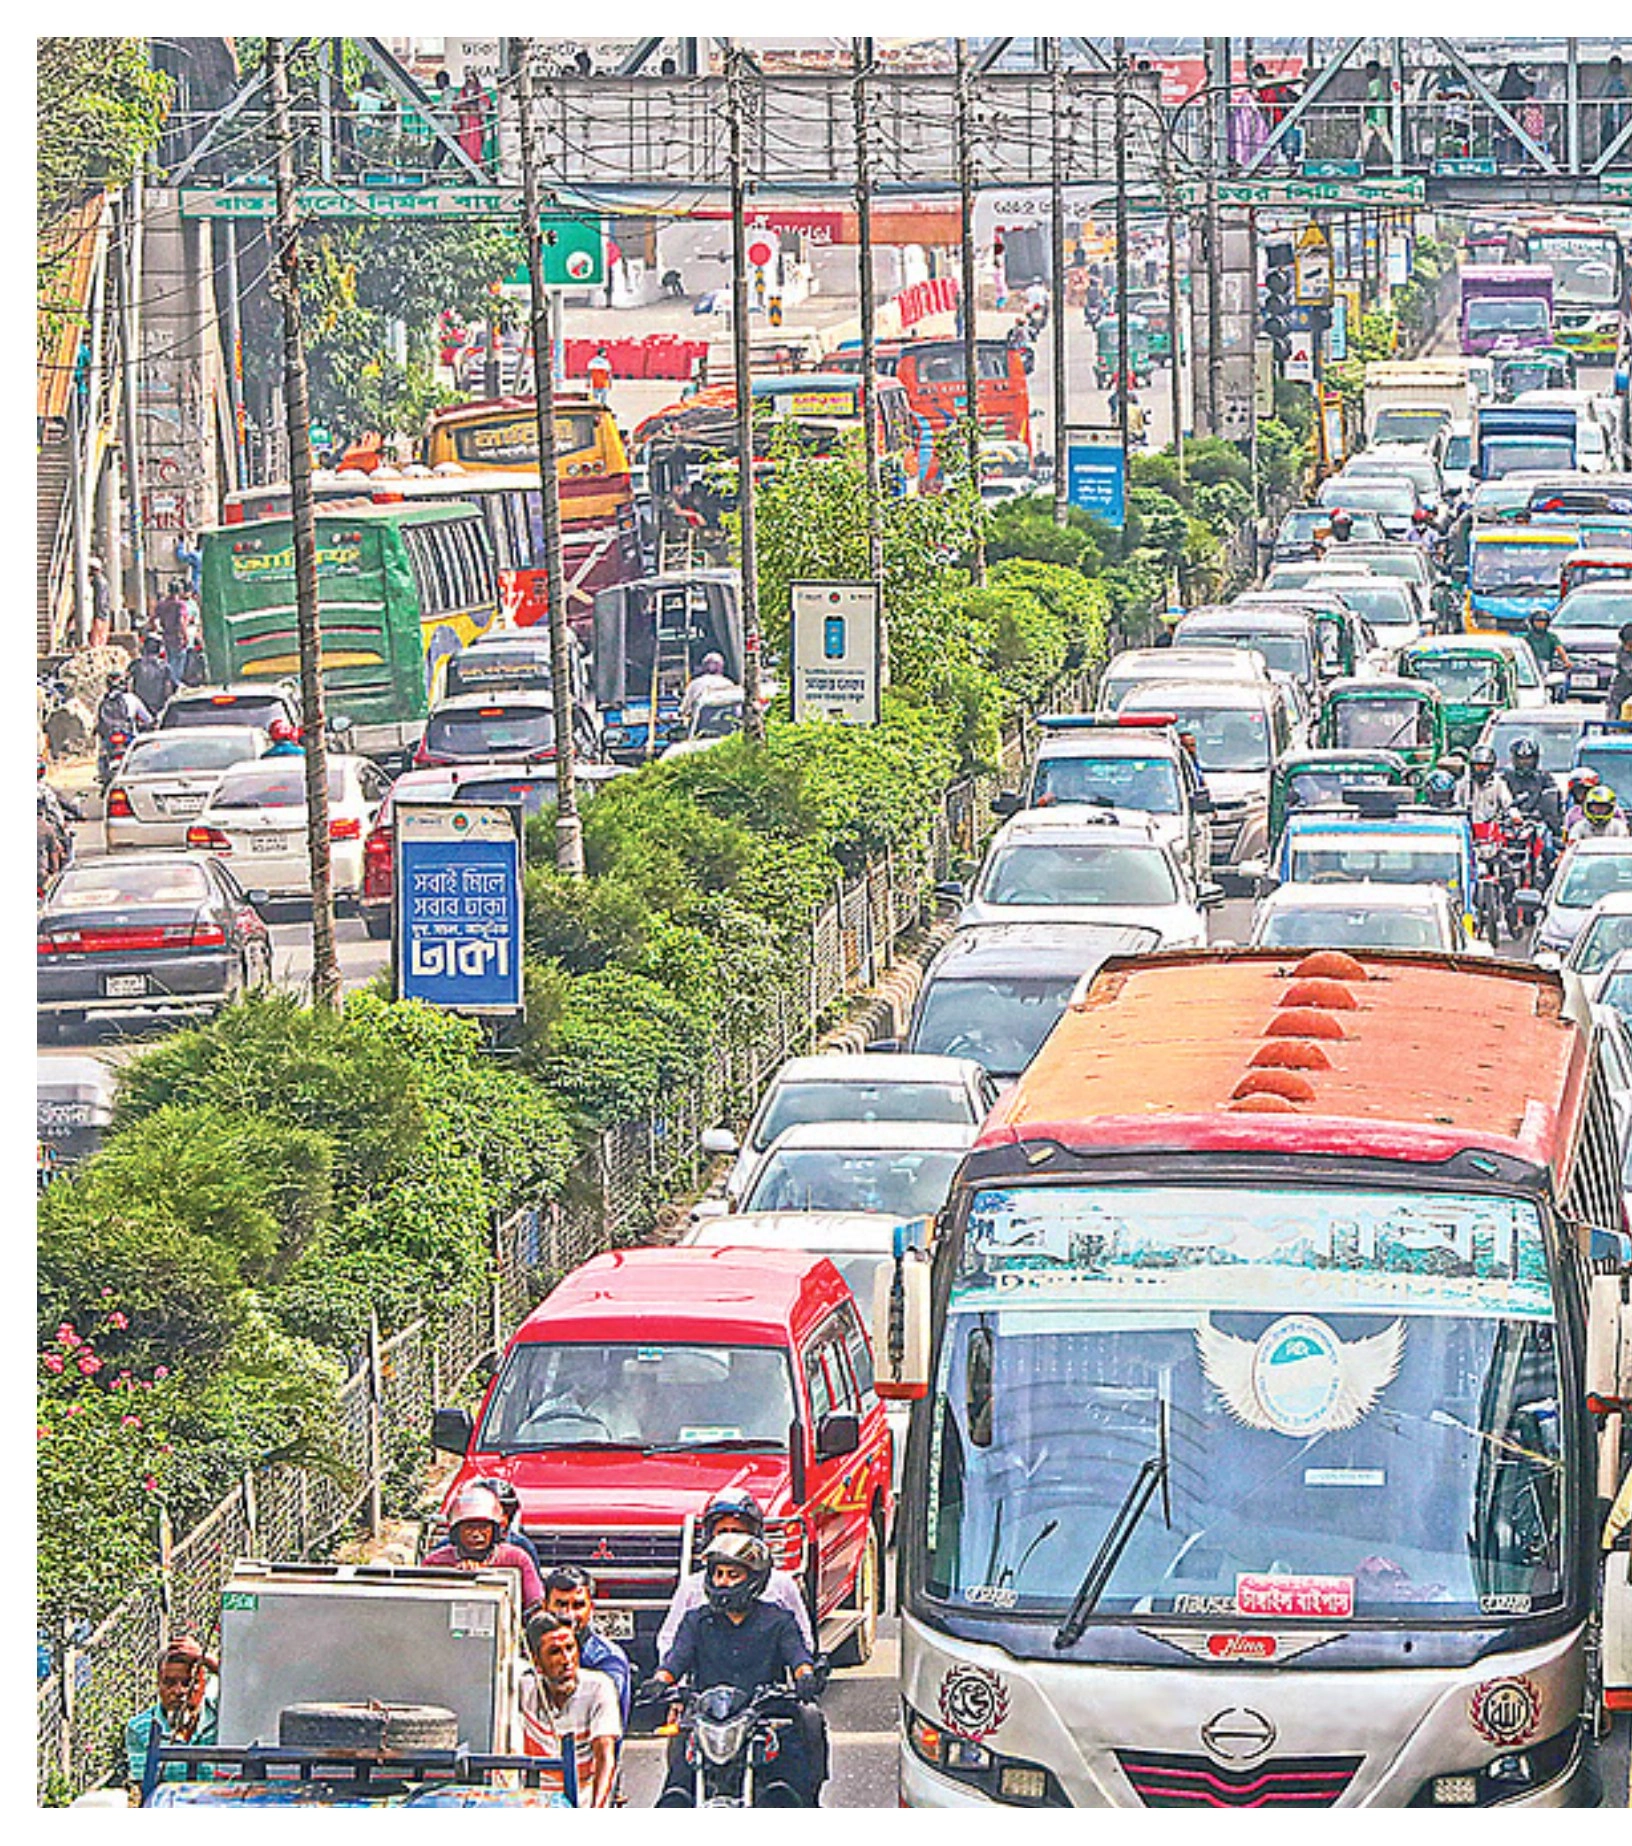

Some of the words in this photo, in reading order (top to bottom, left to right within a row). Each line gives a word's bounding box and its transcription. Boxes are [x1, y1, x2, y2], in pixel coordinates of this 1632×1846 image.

[413, 867, 459, 894] সবাই
[461, 867, 507, 894] মিলে
[465, 897, 507, 917] ঢাকা
[411, 937, 511, 977] ঢাকা
